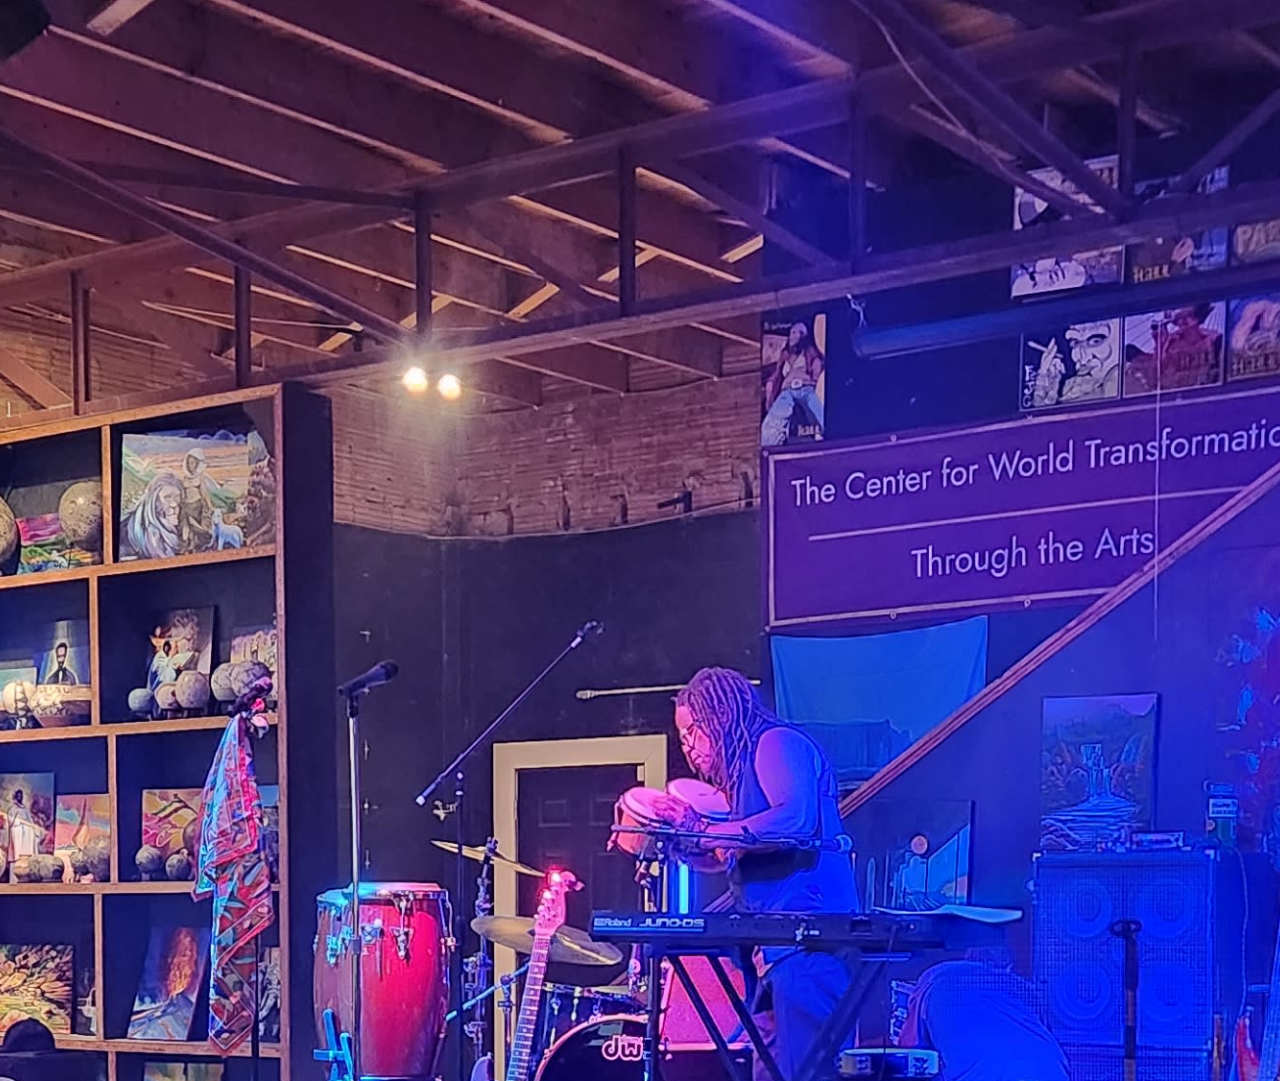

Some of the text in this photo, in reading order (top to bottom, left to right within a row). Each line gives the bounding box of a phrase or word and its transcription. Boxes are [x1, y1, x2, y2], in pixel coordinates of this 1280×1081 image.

[791, 476, 836, 506] The
[845, 469, 932, 500] Center
[941, 456, 979, 487] for
[988, 440, 1073, 481] World
[911, 527, 1154, 577] Through the Arts
[601, 1034, 644, 1061] dw
